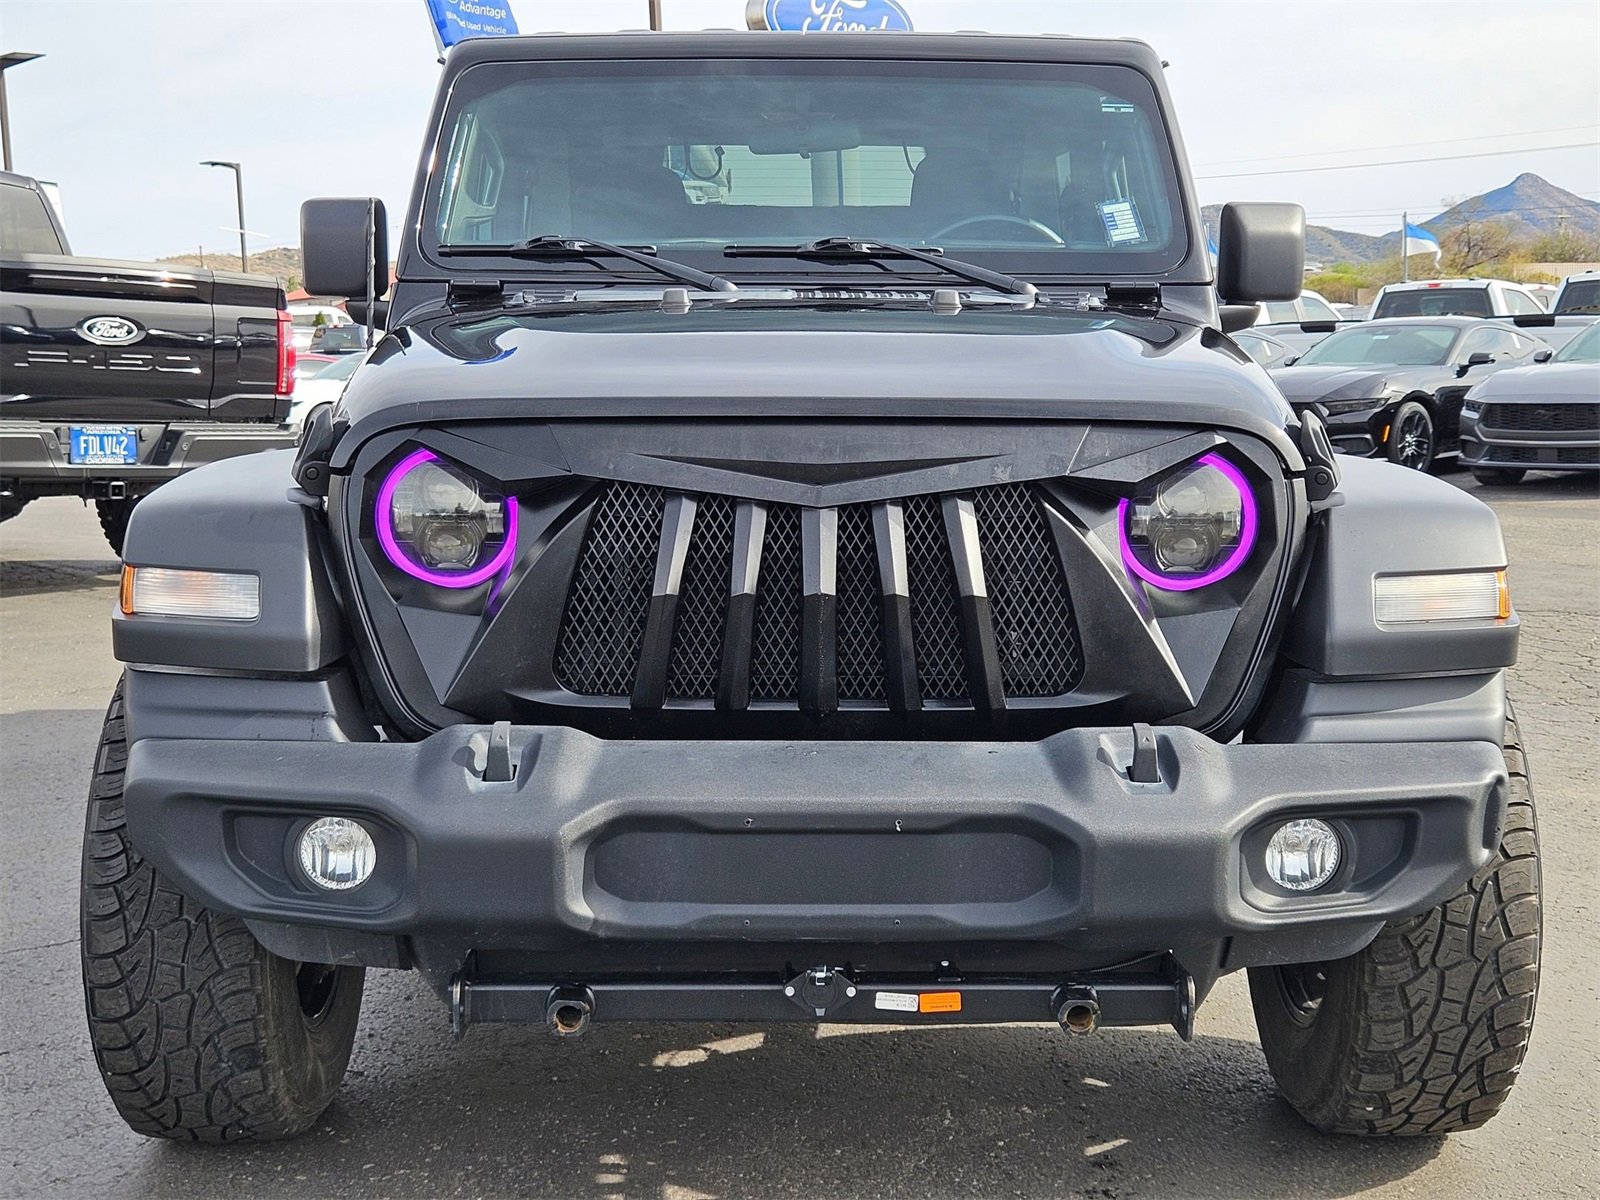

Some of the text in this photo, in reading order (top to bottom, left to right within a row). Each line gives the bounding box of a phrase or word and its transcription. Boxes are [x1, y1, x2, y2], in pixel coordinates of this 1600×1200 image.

[459, 1, 507, 19] Advantage
[482, 24, 507, 35] Vehicle
[91, 320, 129, 338] Ford
[80, 435, 129, 455] FDLV42
